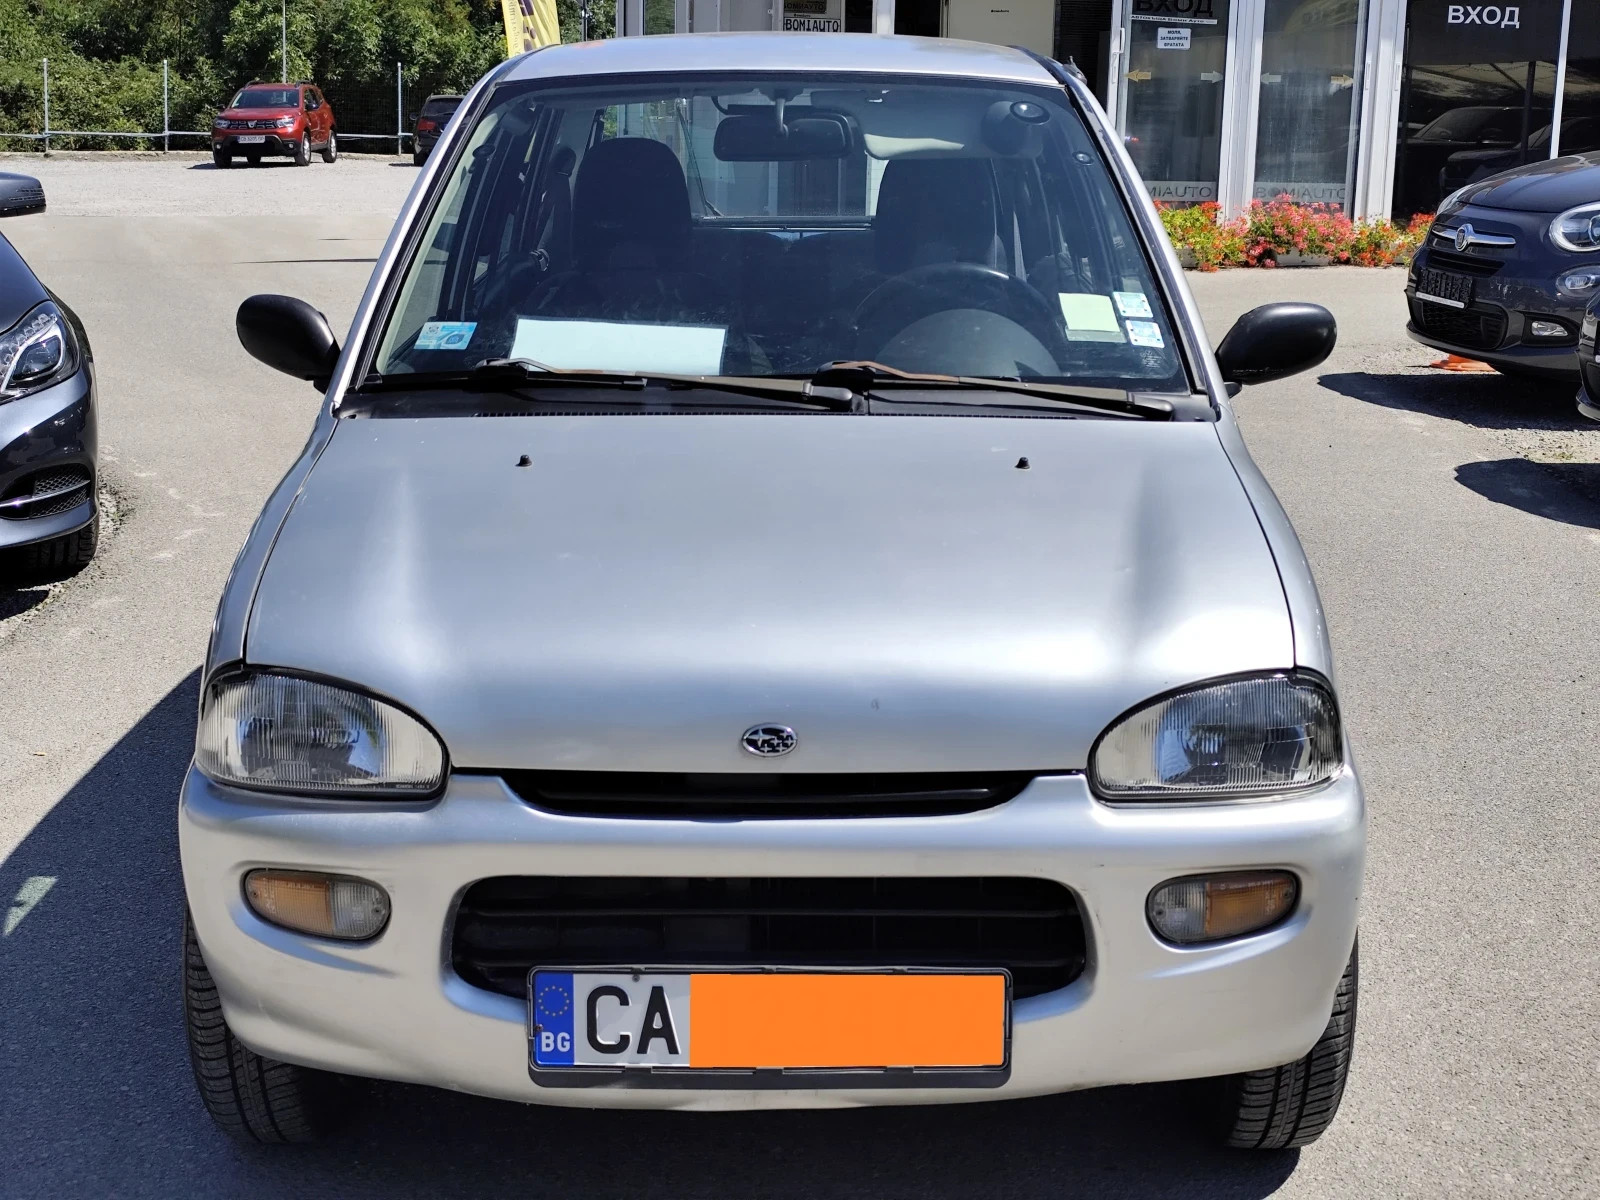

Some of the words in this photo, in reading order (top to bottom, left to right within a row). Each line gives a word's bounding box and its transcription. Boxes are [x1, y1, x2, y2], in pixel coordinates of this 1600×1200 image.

[785, 18, 839, 32] BOMIAUTO
[1447, 5, 1520, 29] ВХОД
[1148, 186, 1212, 198] MIAUTO
[587, 985, 681, 1055] CA
[541, 1032, 570, 1052] BG
